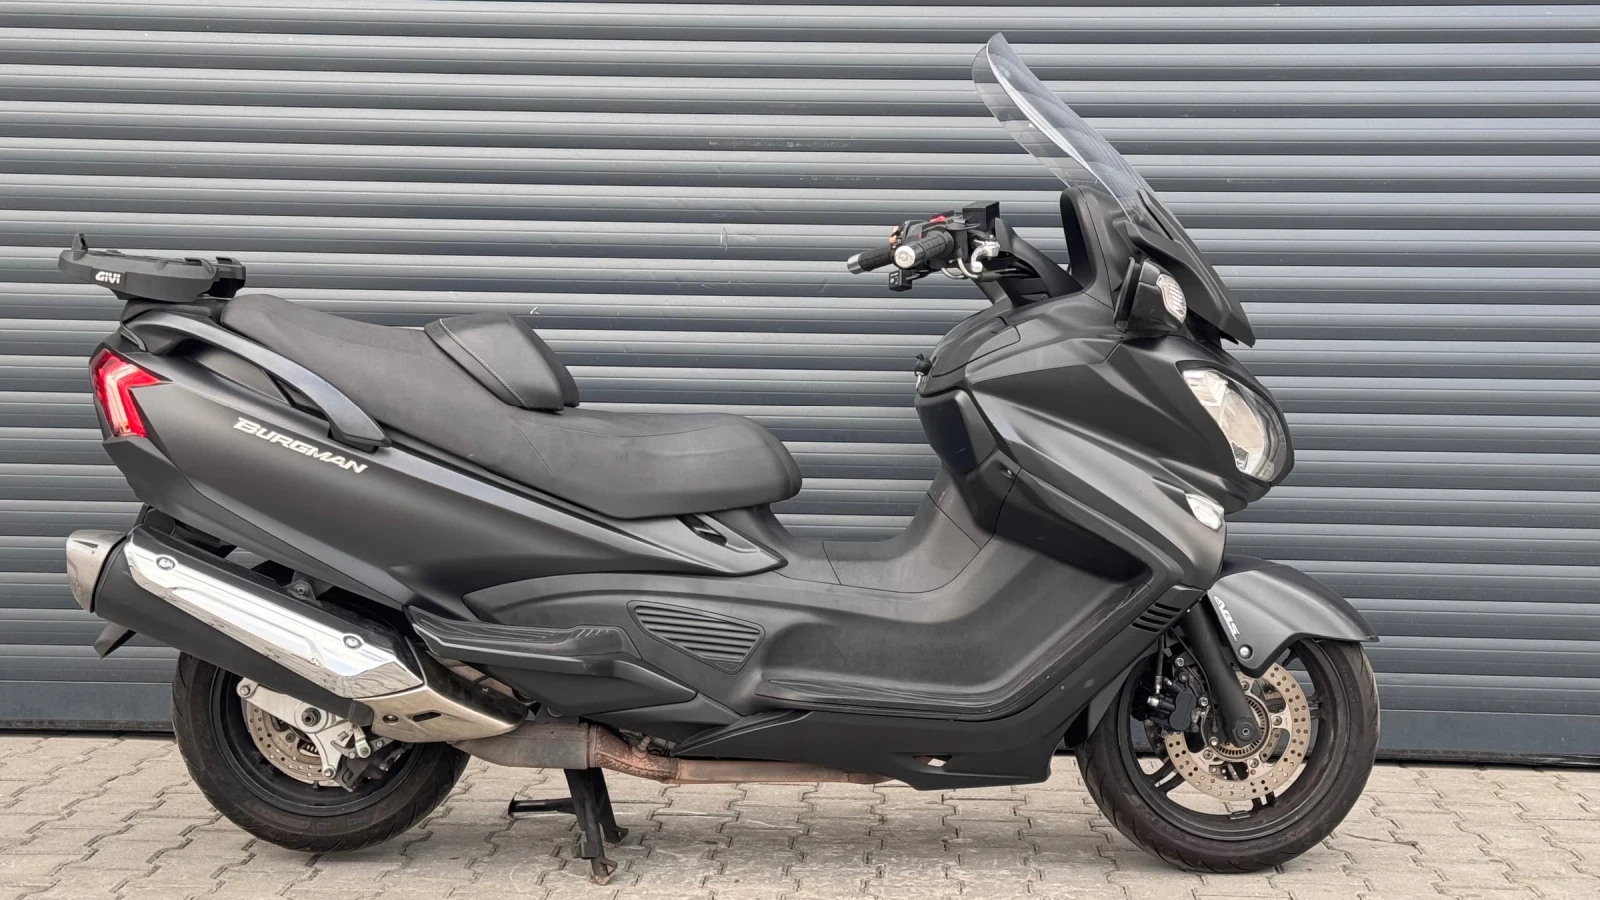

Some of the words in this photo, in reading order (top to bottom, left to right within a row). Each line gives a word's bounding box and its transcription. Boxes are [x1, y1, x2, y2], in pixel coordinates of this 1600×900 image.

[95, 271, 121, 284] GIVI
[233, 416, 368, 473] BURGMAN
[1213, 595, 1240, 641] ABS
